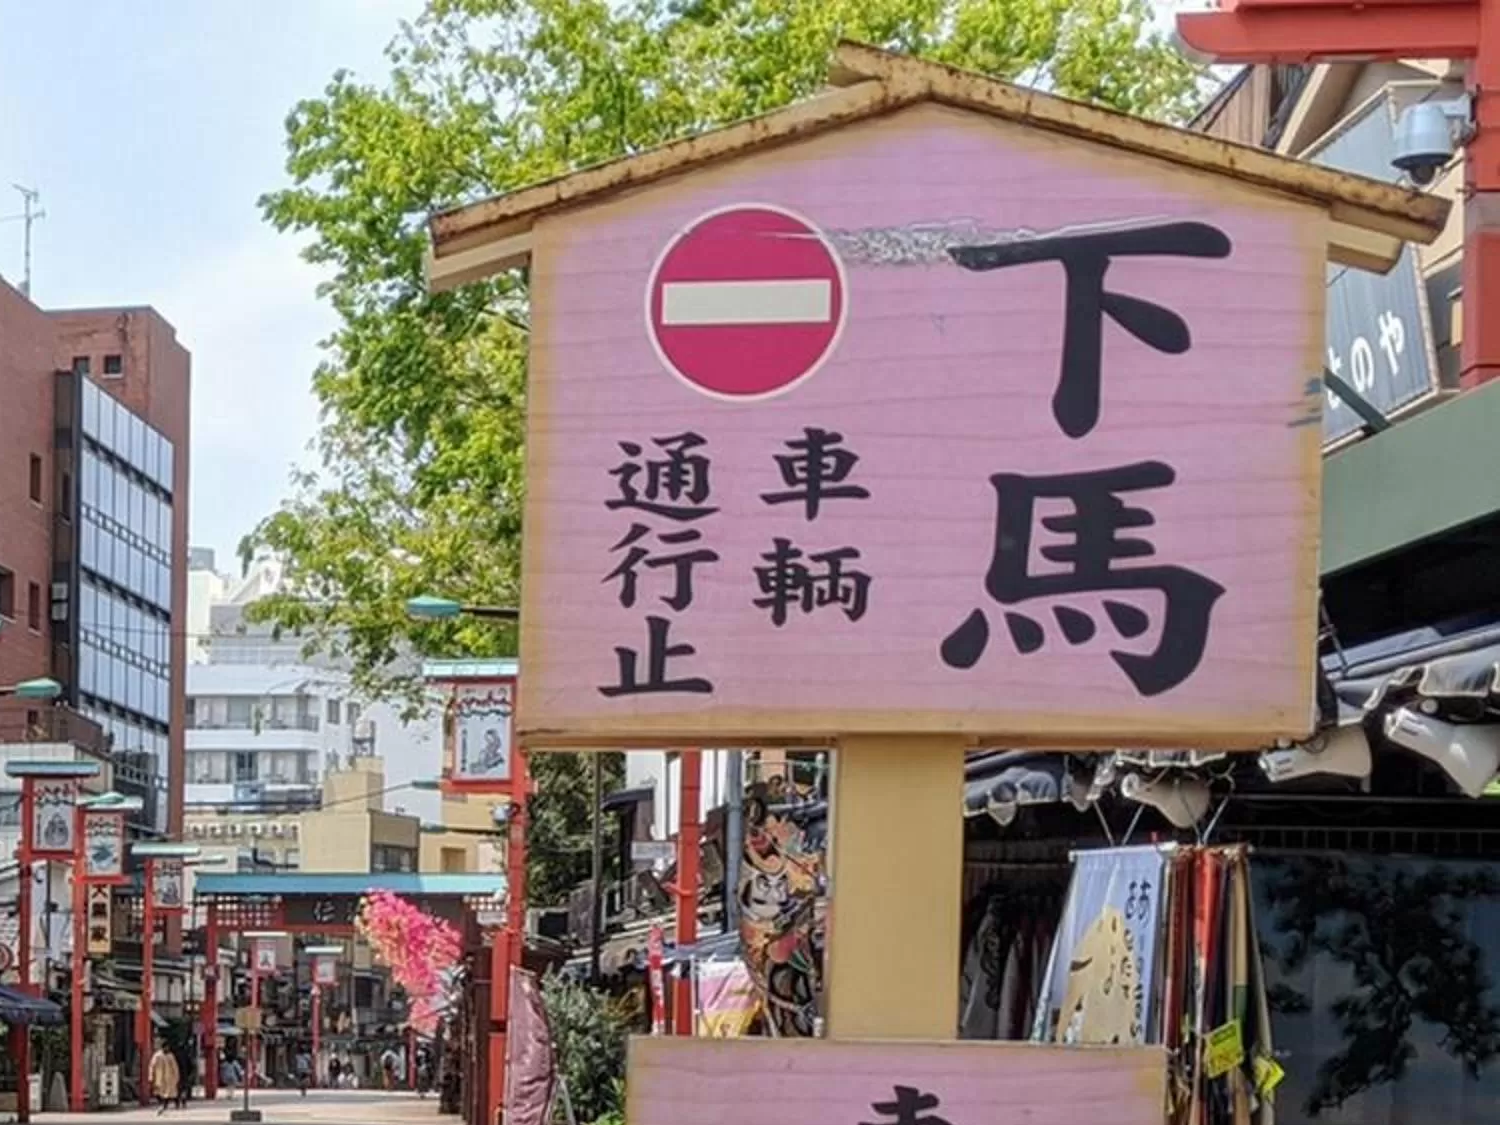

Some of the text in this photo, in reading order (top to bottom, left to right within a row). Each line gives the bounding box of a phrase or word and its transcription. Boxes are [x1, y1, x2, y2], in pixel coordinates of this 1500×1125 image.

[599, 432, 719, 697] 通行止
[753, 428, 871, 626] 車輌
[942, 223, 1231, 696] 下馬
